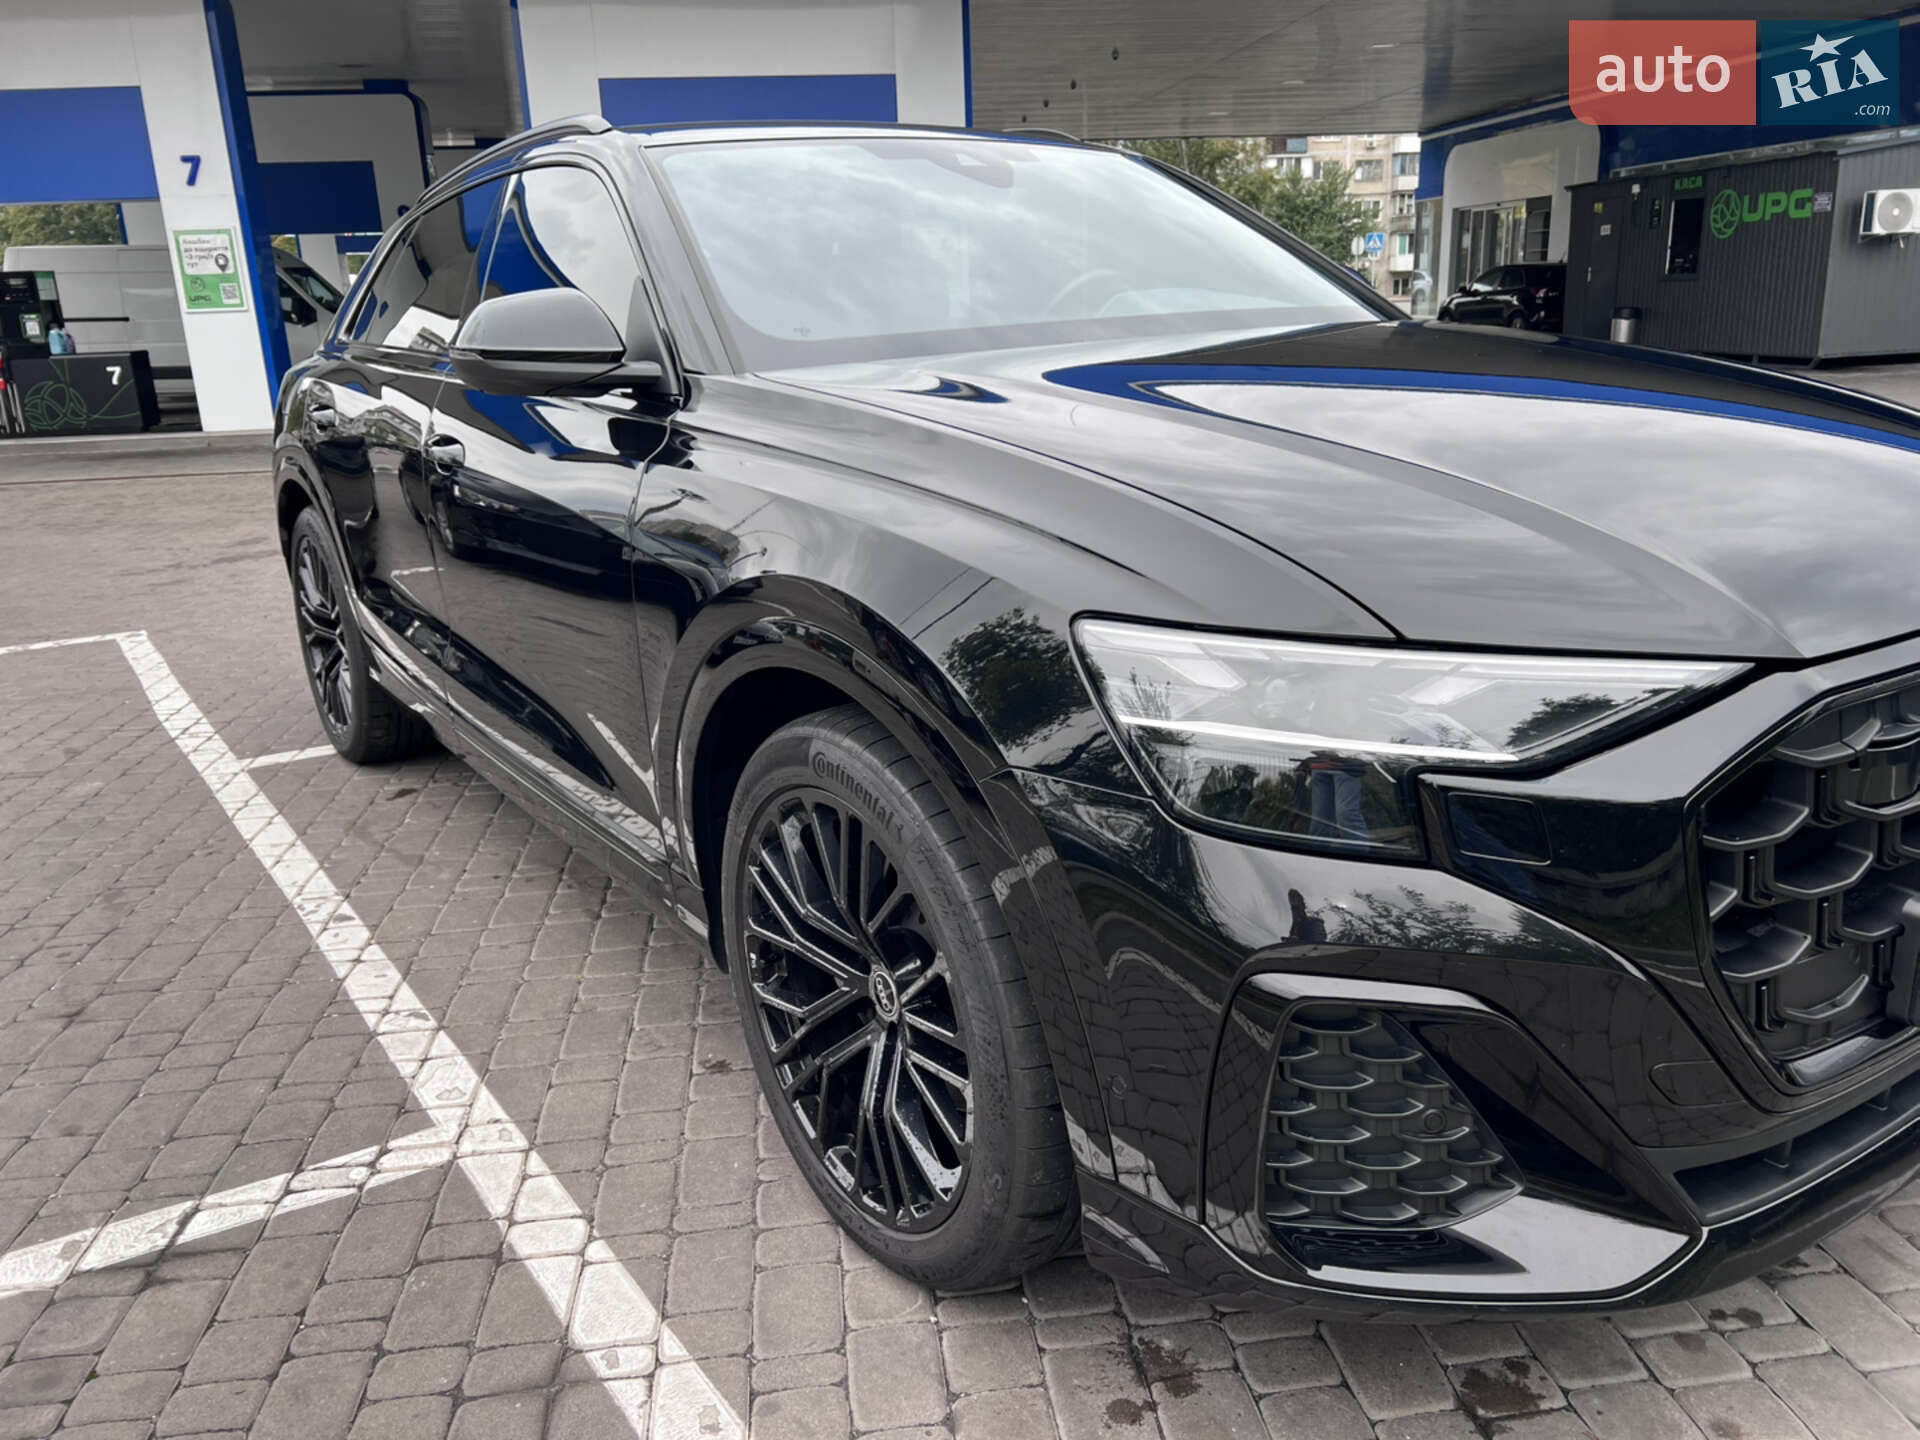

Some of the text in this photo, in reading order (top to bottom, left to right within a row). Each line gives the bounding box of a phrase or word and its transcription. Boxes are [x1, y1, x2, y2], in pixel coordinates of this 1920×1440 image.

[180, 154, 202, 186] 7
[1742, 187, 1814, 223] UPG
[105, 365, 122, 385] 7
[812, 751, 895, 831] Continental
